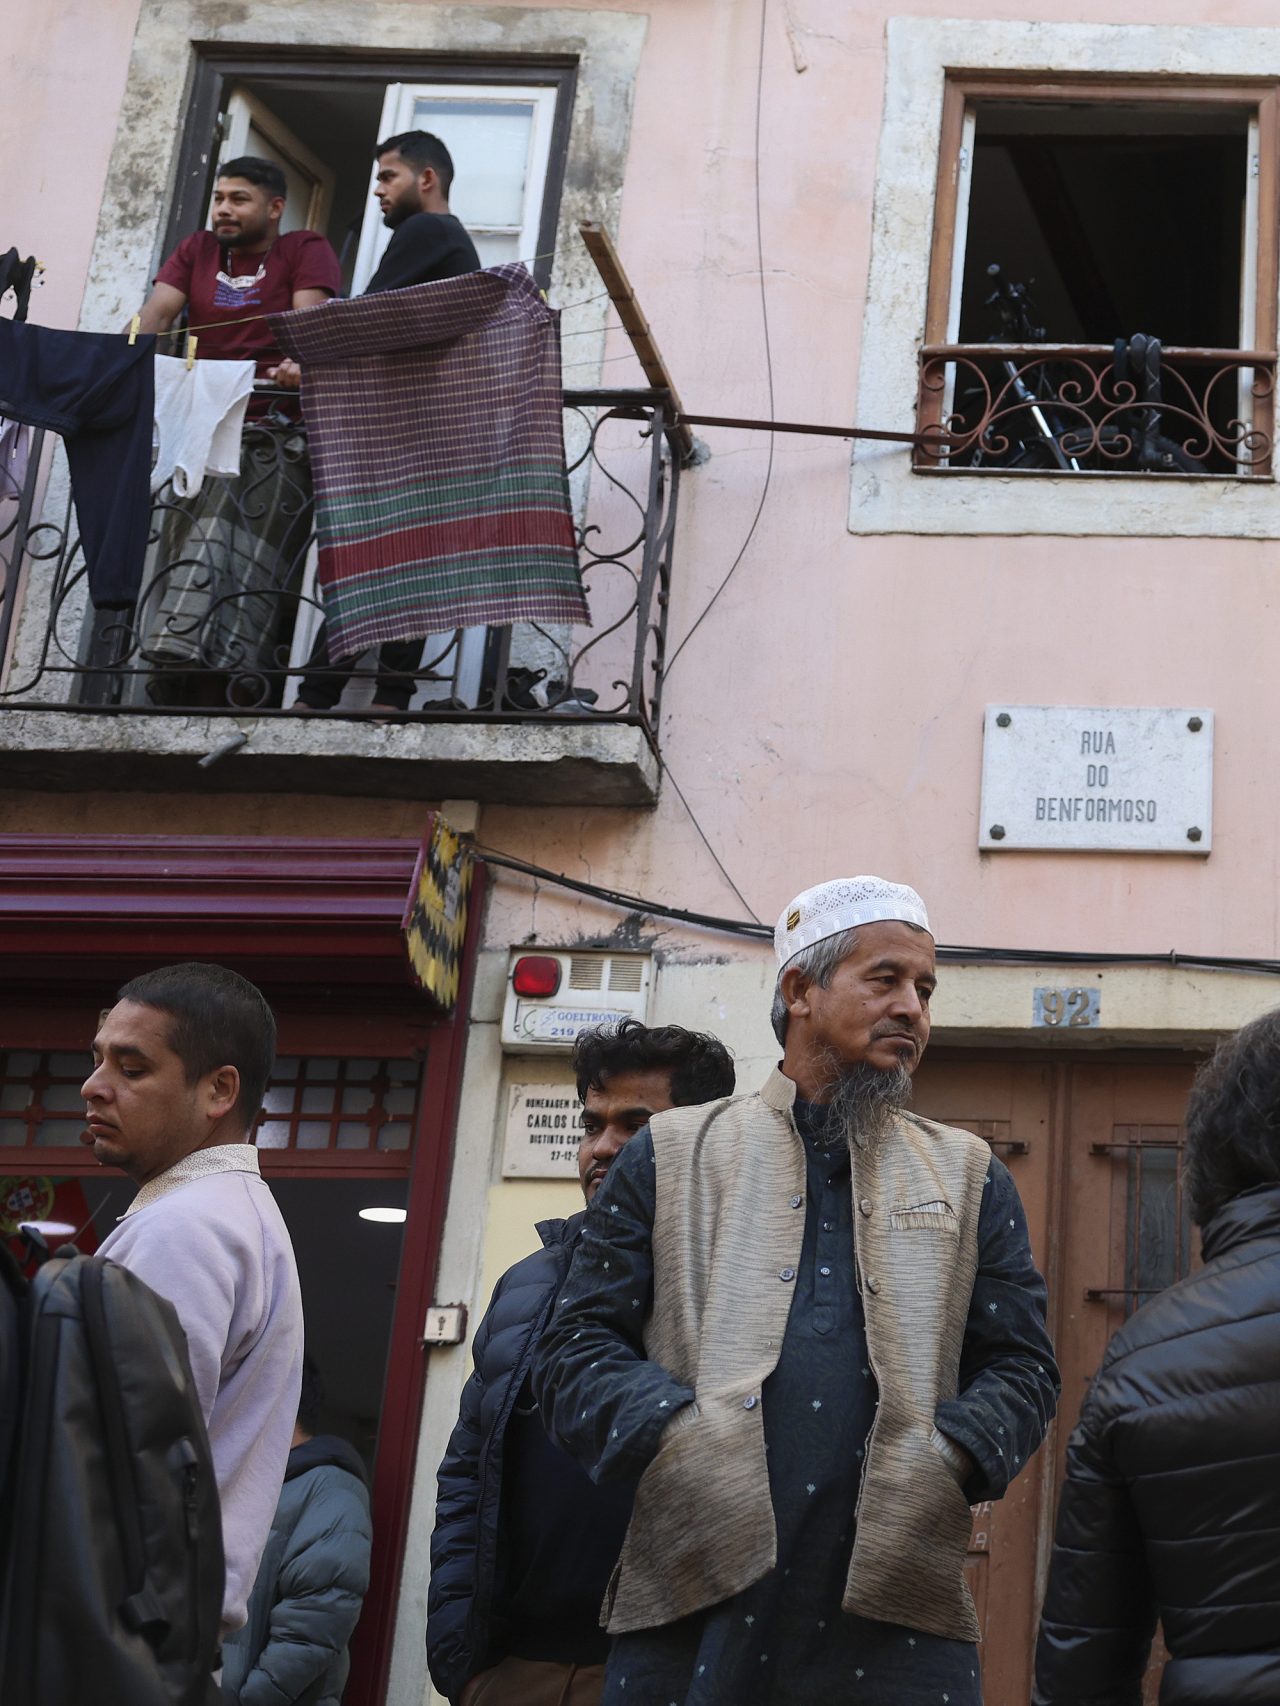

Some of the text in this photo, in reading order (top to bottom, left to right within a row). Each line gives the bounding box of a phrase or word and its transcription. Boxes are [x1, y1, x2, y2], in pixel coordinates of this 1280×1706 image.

[1081, 731, 1116, 754] RUA
[1087, 764, 1109, 787] DO
[1036, 797, 1157, 822] BENFORMOSO
[1043, 990, 1090, 1027] 92
[551, 1027, 574, 1036] 219
[526, 1098, 581, 1109] HOMENAGEM DE
[527, 1114, 567, 1129] CARLOS
[530, 1134, 564, 1144] DISTINTO
